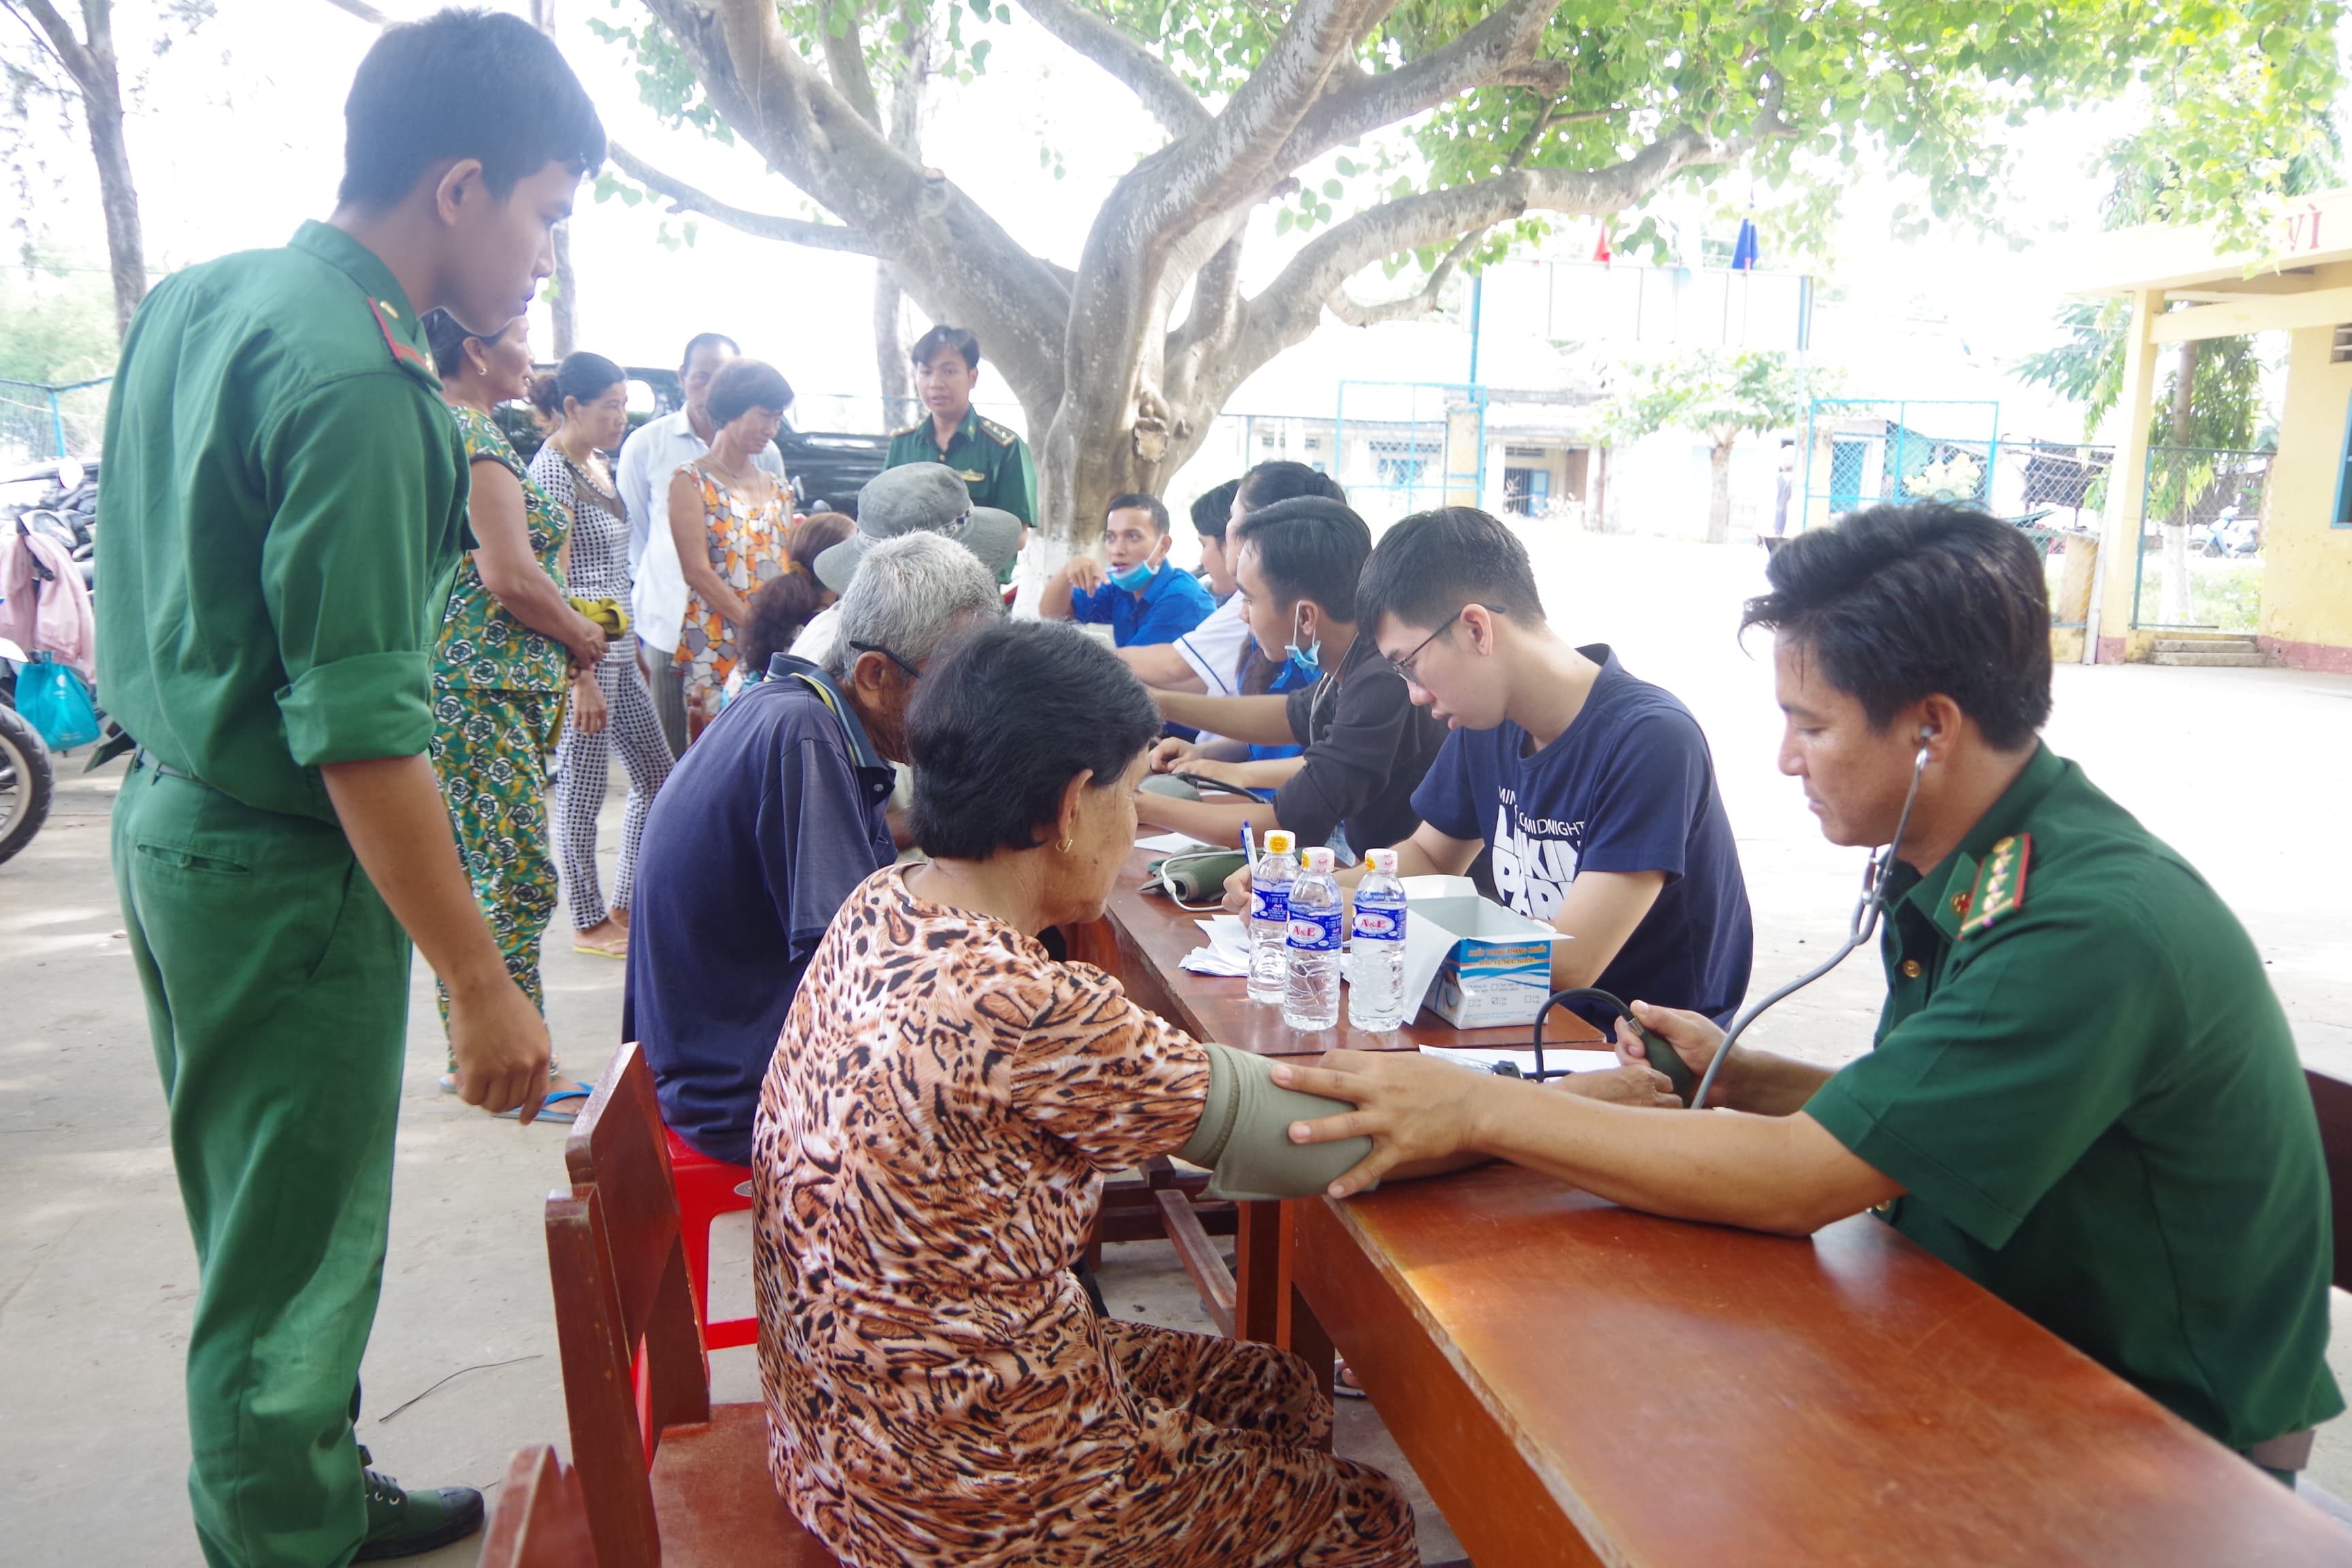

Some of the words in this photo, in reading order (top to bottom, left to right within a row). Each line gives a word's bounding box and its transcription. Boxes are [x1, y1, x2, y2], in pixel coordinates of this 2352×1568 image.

[1524, 817, 1585, 836] MIDNIGHT
[1492, 845, 1573, 919] PAR
[1293, 925, 1316, 938] A&E
[1361, 918, 1386, 929] A&E
